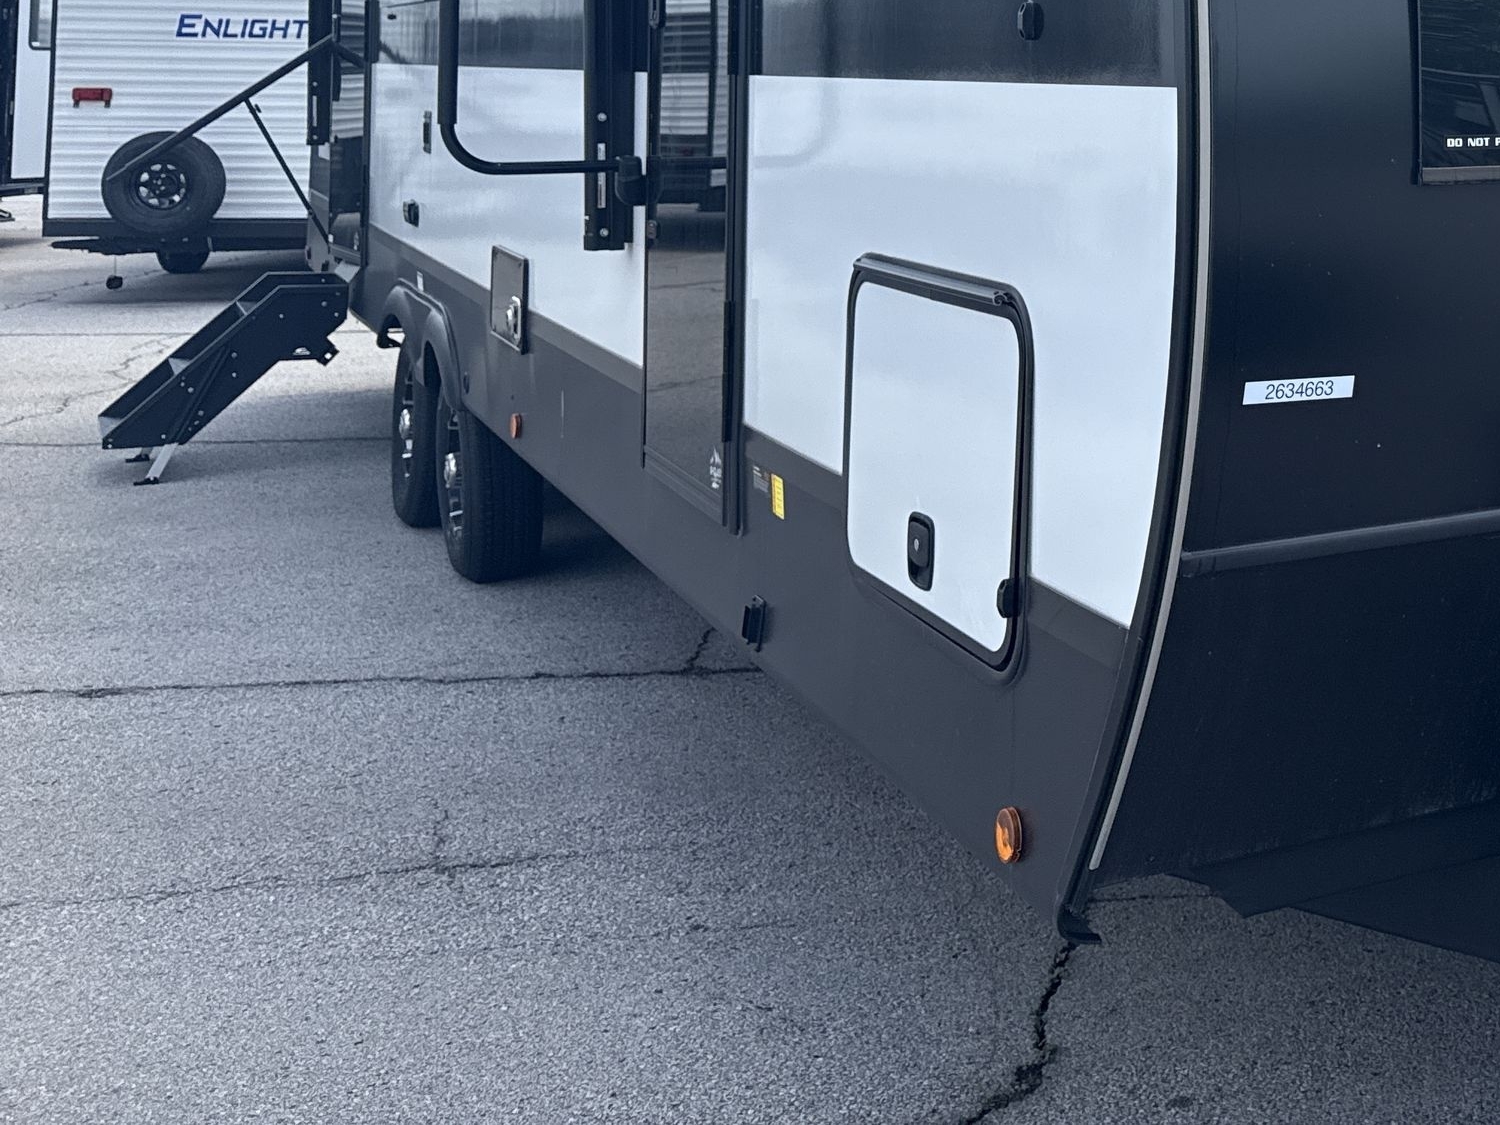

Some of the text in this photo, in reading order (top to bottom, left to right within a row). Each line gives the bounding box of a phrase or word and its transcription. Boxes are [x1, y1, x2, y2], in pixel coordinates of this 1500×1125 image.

[1446, 137, 1463, 148] DO
[1467, 136, 1490, 147] NOT
[1265, 379, 1334, 400] 2634663
